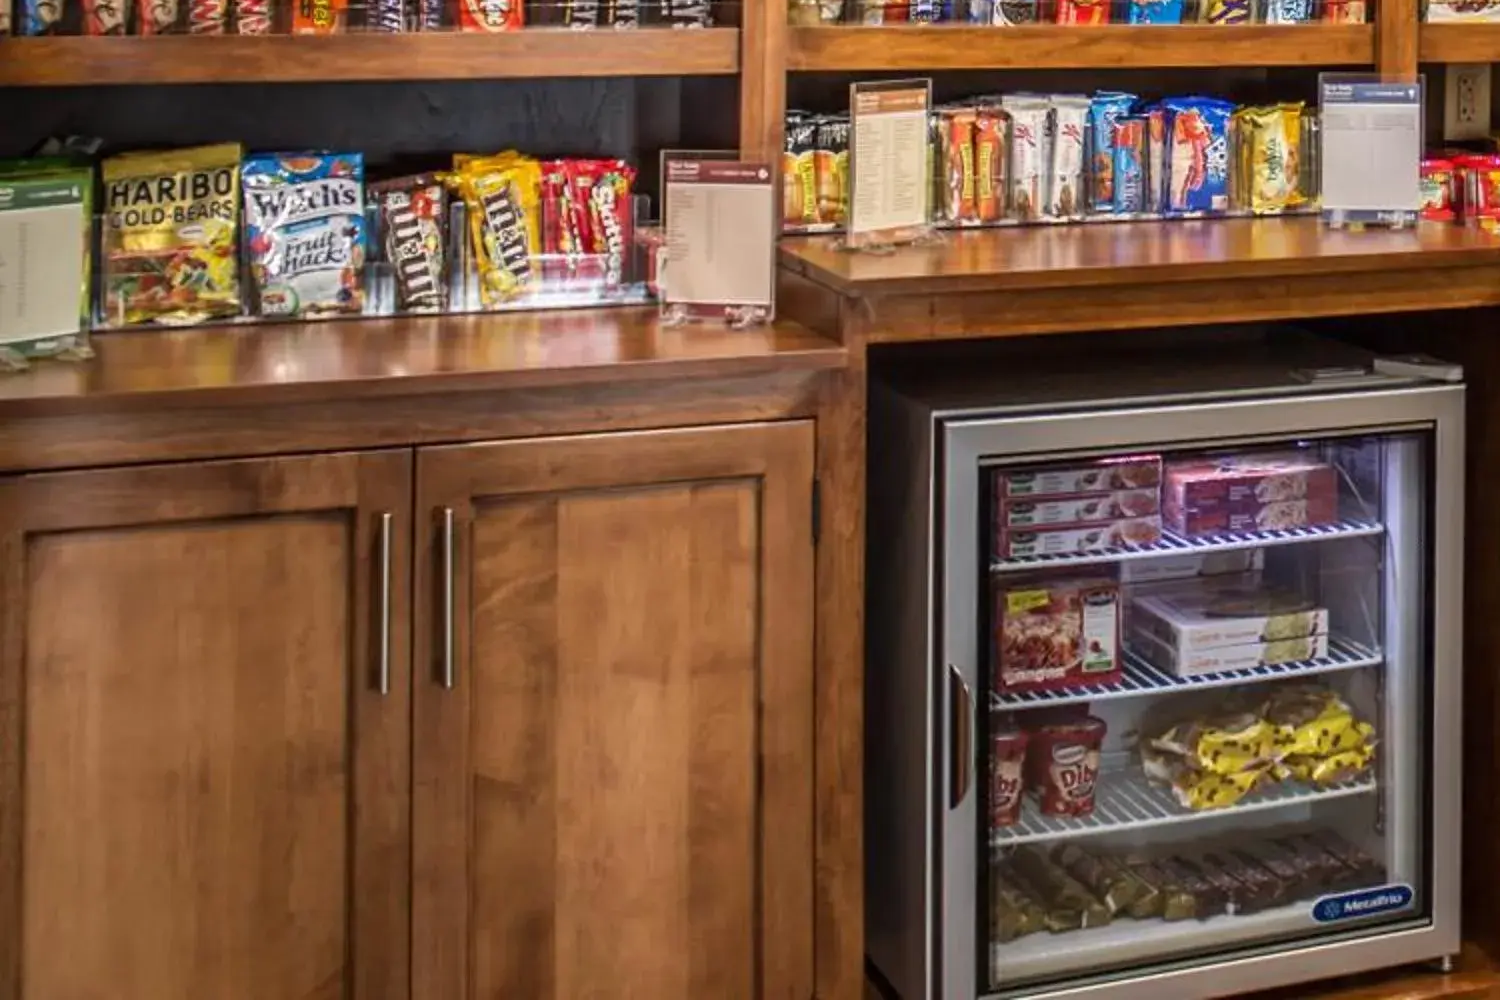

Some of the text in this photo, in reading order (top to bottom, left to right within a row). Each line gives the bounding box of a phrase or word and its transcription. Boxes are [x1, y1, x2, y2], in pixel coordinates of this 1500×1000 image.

[111, 168, 233, 208] HARIBO
[111, 199, 233, 230] GOLD-BEARS
[1062, 760, 1095, 788] Dib
